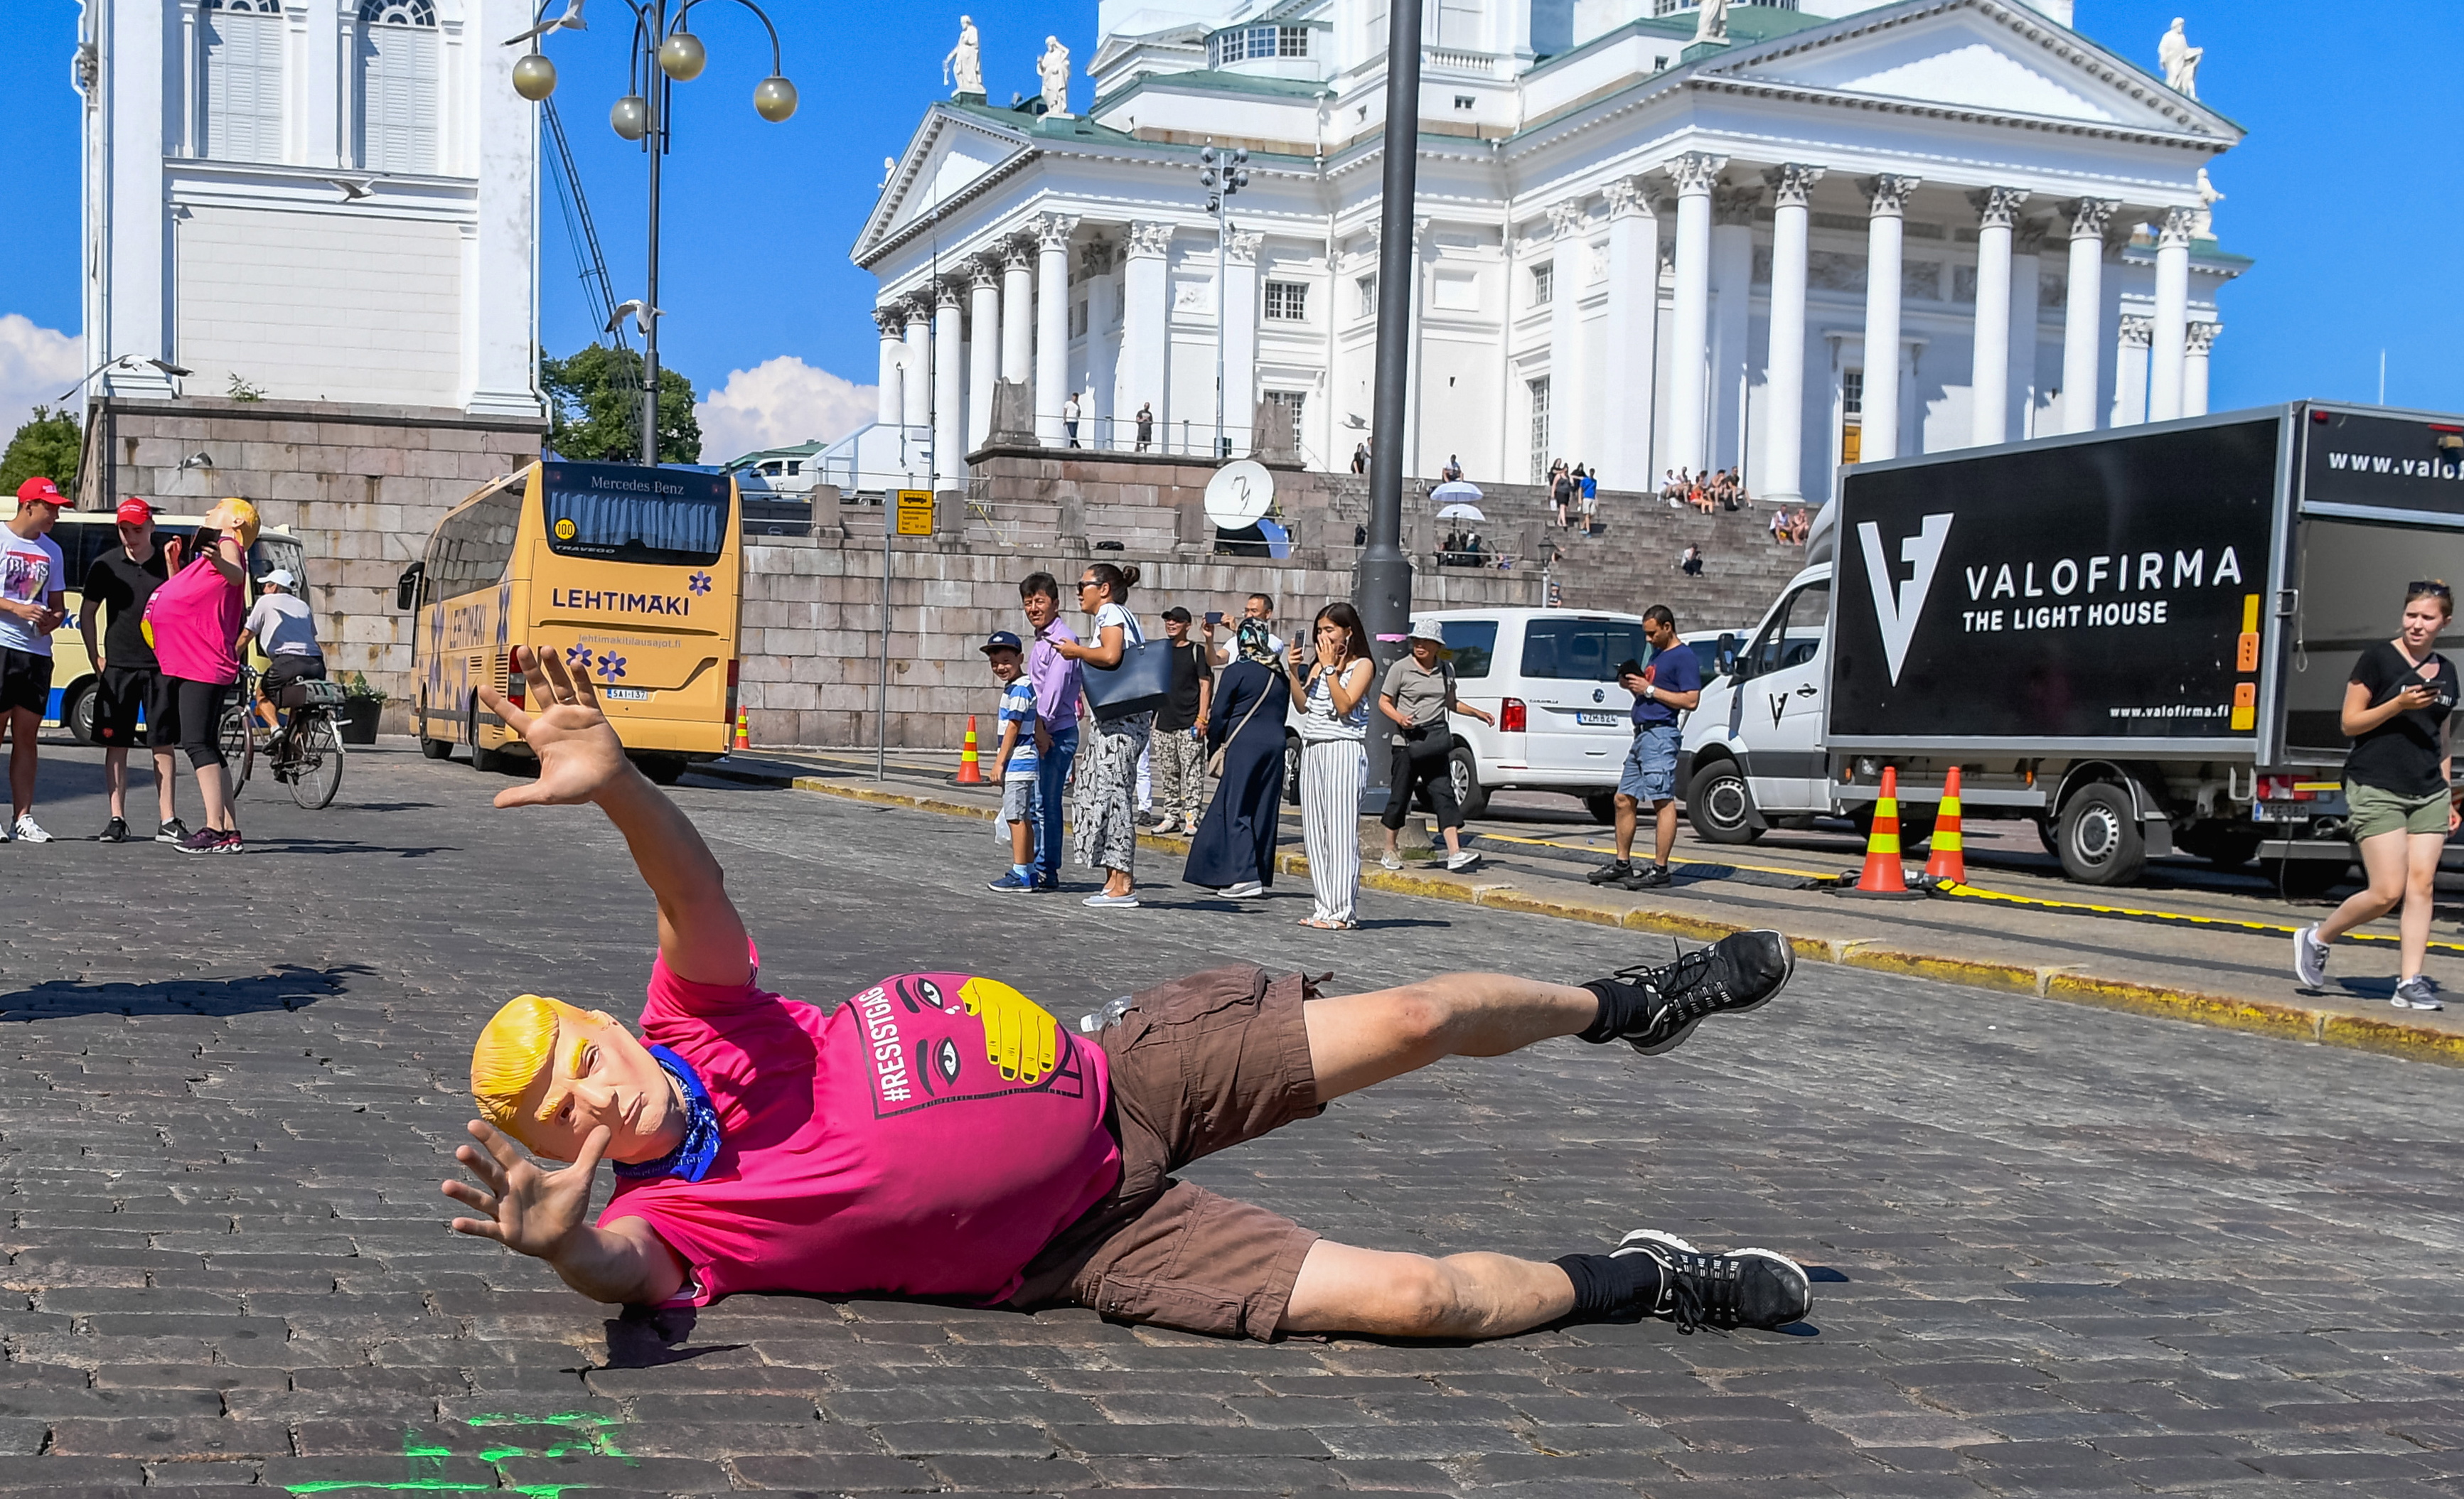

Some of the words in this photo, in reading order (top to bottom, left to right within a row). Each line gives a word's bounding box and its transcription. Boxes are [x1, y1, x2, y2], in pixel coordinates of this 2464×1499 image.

[591, 476, 684, 495] Mercedes-Benz
[557, 523, 573, 536] 100
[555, 545, 616, 554] TRAVEGO
[1965, 544, 2242, 602] VALOFIRMA
[1962, 609, 2004, 633] THE
[2013, 604, 2082, 630] LIGHT
[2087, 600, 2168, 628] HOUSE
[2110, 704, 2229, 718] www.valofirma.fi
[858, 986, 911, 1102] #RESISTGAG
